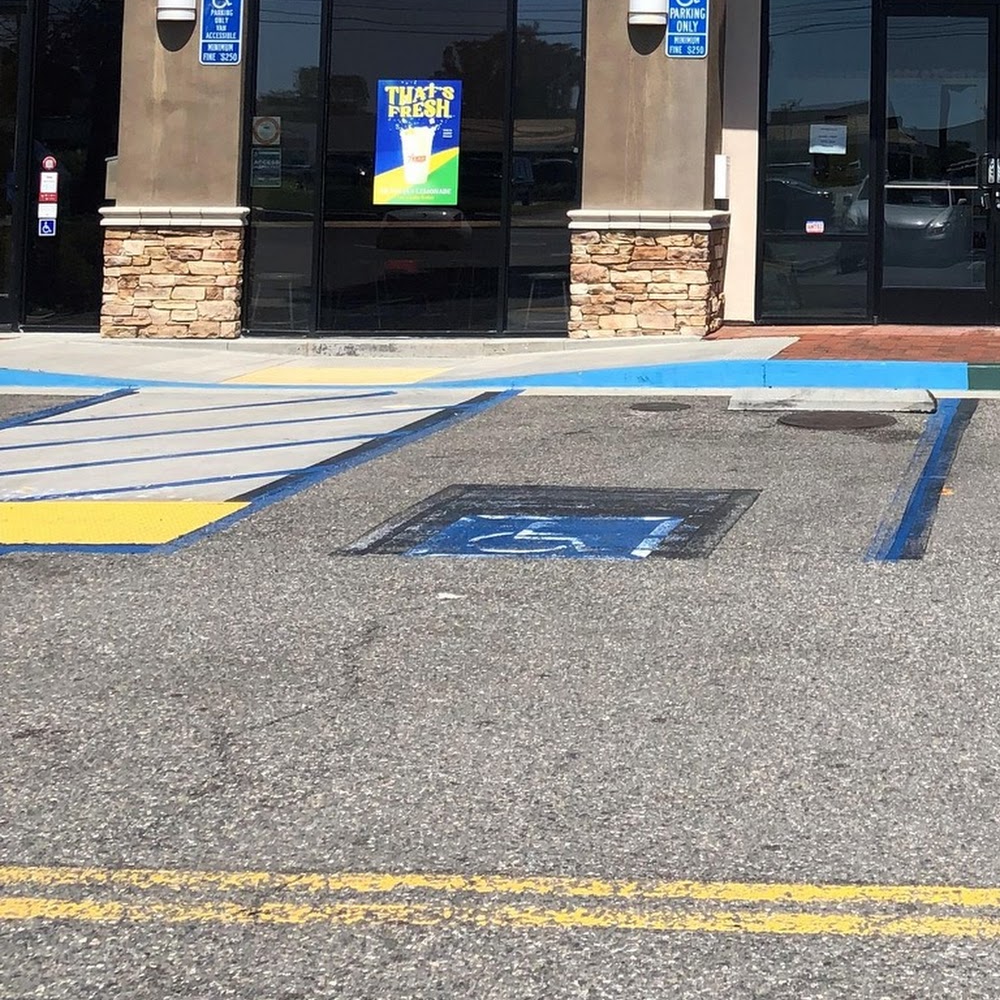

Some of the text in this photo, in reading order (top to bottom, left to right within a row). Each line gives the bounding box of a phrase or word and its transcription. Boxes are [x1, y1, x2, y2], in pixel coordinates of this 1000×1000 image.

[210, 9, 234, 17] PARKING
[669, 7, 706, 20] PARKING
[676, 20, 699, 33] ONLY
[205, 31, 237, 39] ACCESSIBLE
[669, 45, 705, 55] FINE $250
[202, 52, 216, 61] FINE
[387, 98, 451, 118] FRESH
